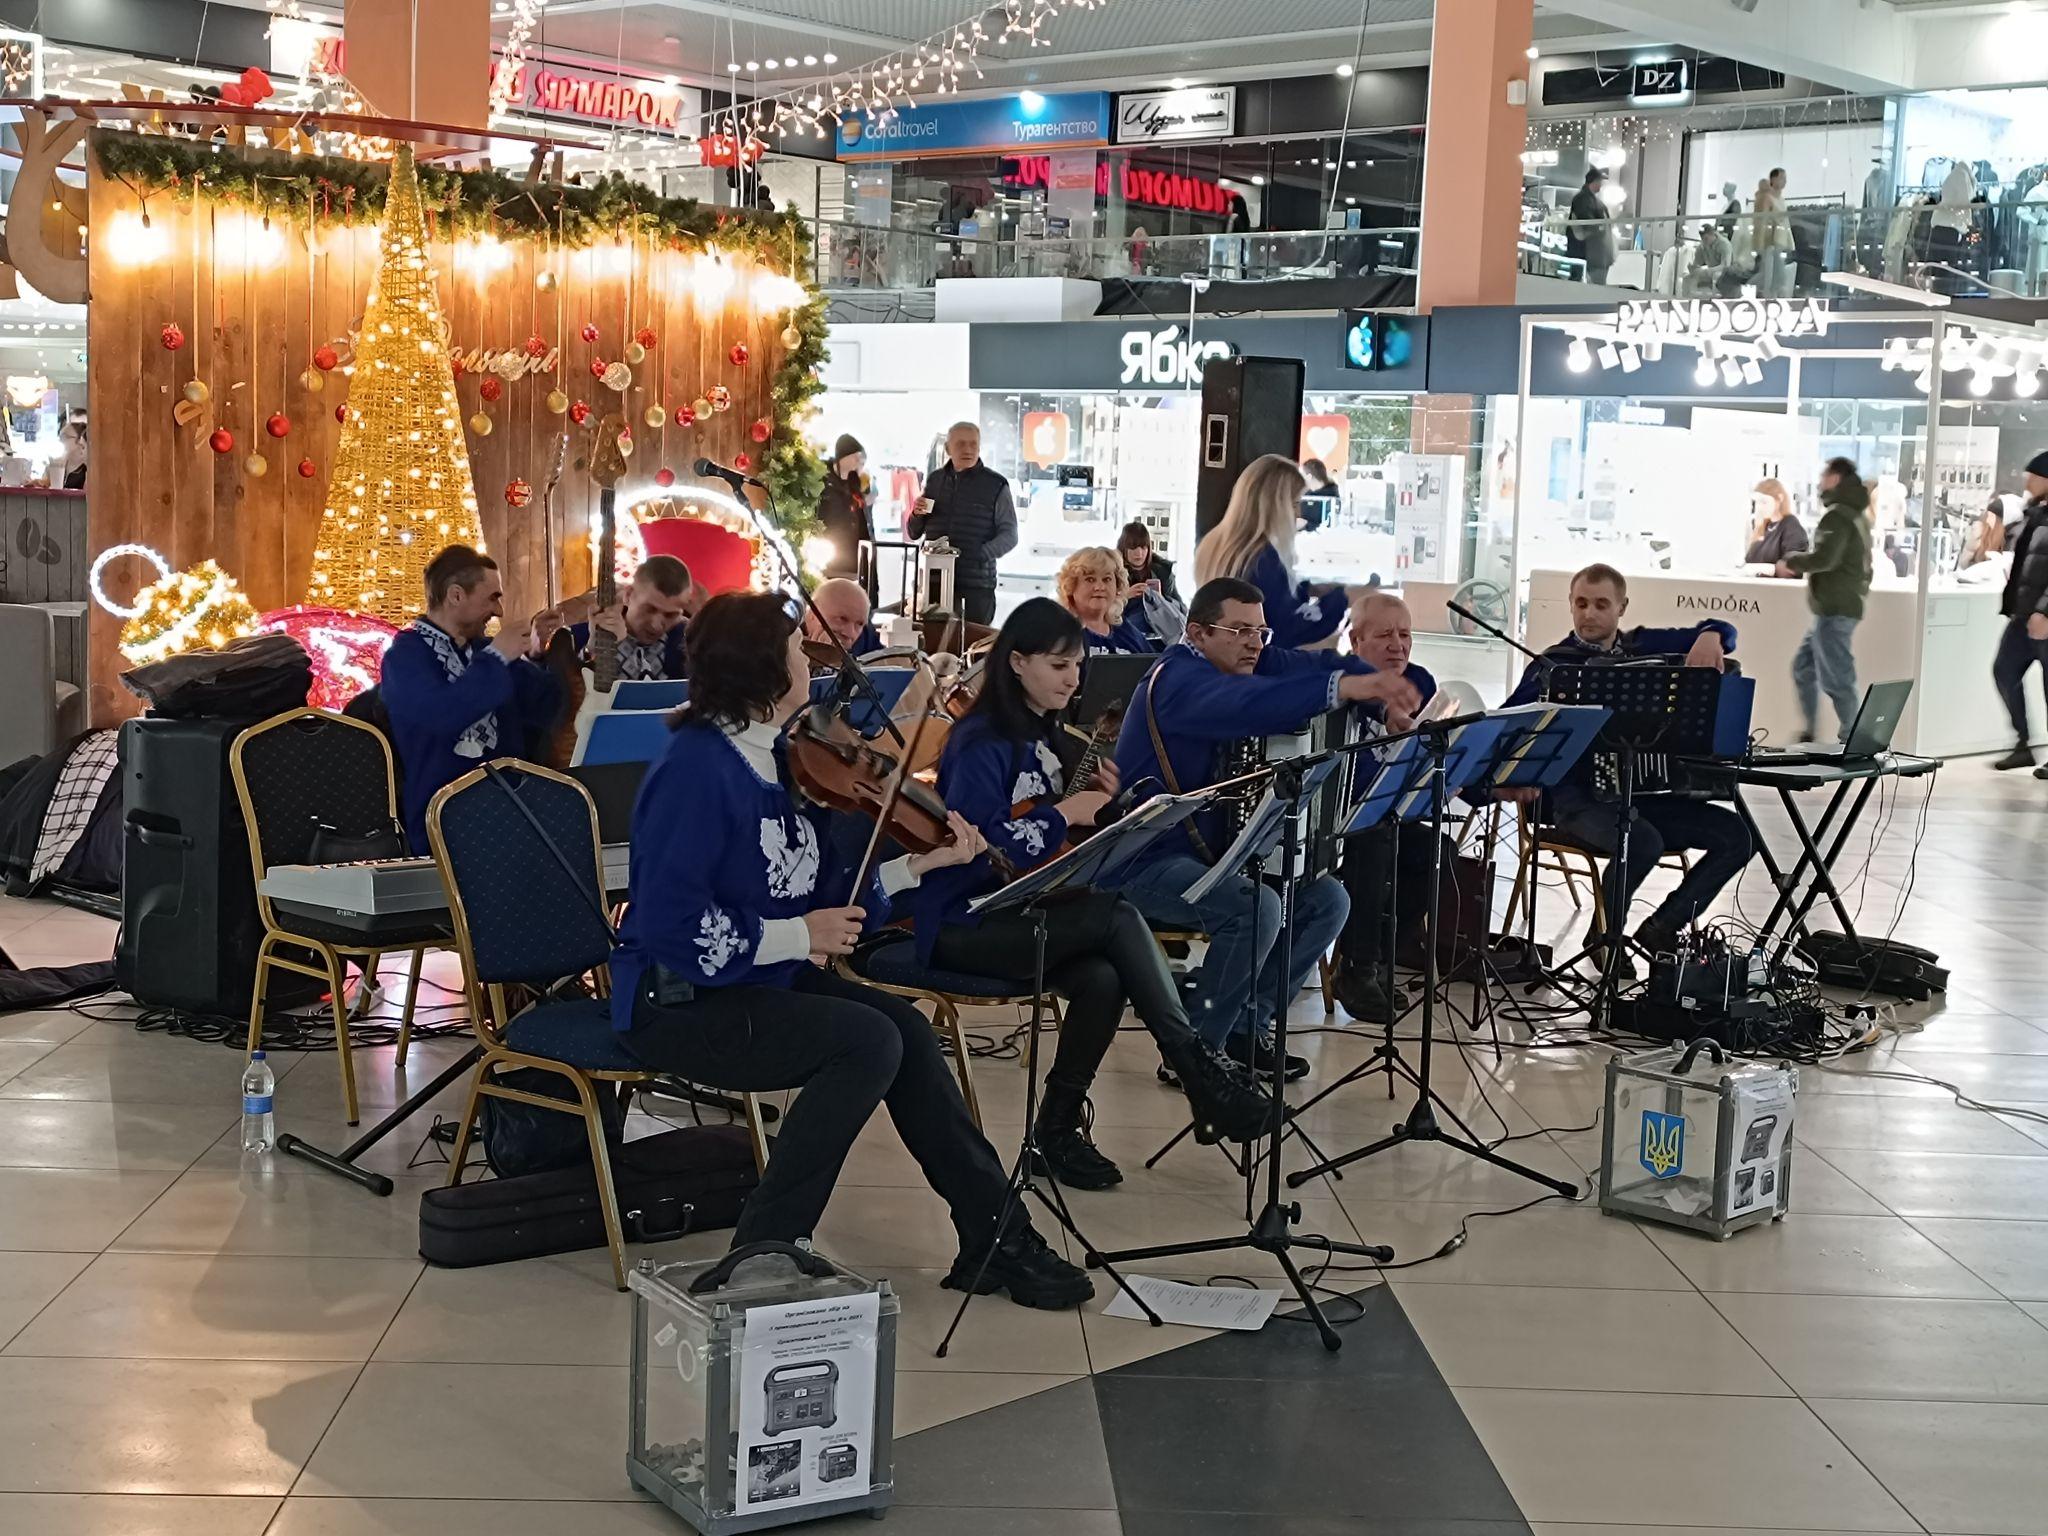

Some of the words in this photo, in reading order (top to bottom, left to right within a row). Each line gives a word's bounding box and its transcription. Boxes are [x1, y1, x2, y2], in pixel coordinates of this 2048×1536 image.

[1641, 69, 1675, 89] DZ
[535, 70, 683, 128] ЯРМАРОК
[1012, 120, 1098, 141] Турагентство
[1616, 292, 1828, 337] PANDORA
[1676, 594, 1761, 614] PANDORA
